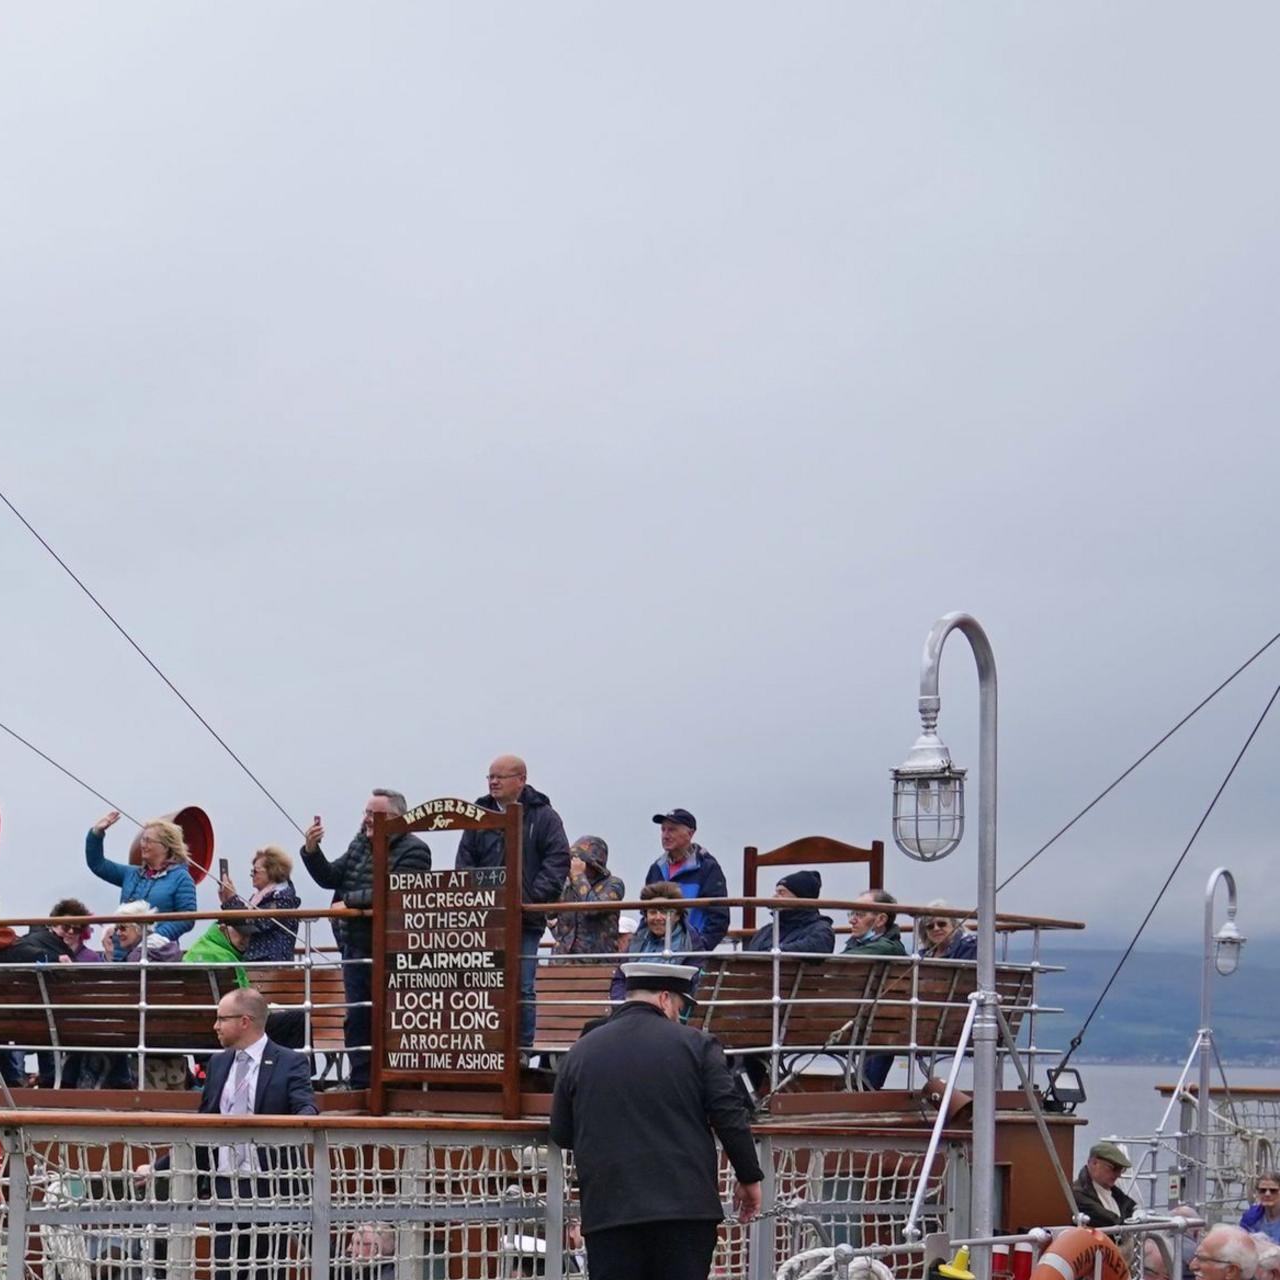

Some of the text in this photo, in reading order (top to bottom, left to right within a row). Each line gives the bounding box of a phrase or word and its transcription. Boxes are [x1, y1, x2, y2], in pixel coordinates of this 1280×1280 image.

[402, 799, 487, 825] WAVERLEY
[428, 814, 454, 831] for
[389, 872, 445, 891] DEPART
[448, 871, 469, 888] AT
[402, 890, 496, 909] KILCREGGAN
[404, 911, 489, 929] ROTHESAY
[407, 931, 487, 949] DUNOON
[396, 951, 496, 970] BLAIRMORE
[388, 971, 505, 989] AFTERNOON CRUISE
[396, 991, 495, 1010] LOCH GOIL
[391, 1011, 500, 1030] LOCH LONG
[400, 1033, 486, 1050] ARROCHAR
[388, 1052, 505, 1070] WITH TIME ASHORE
